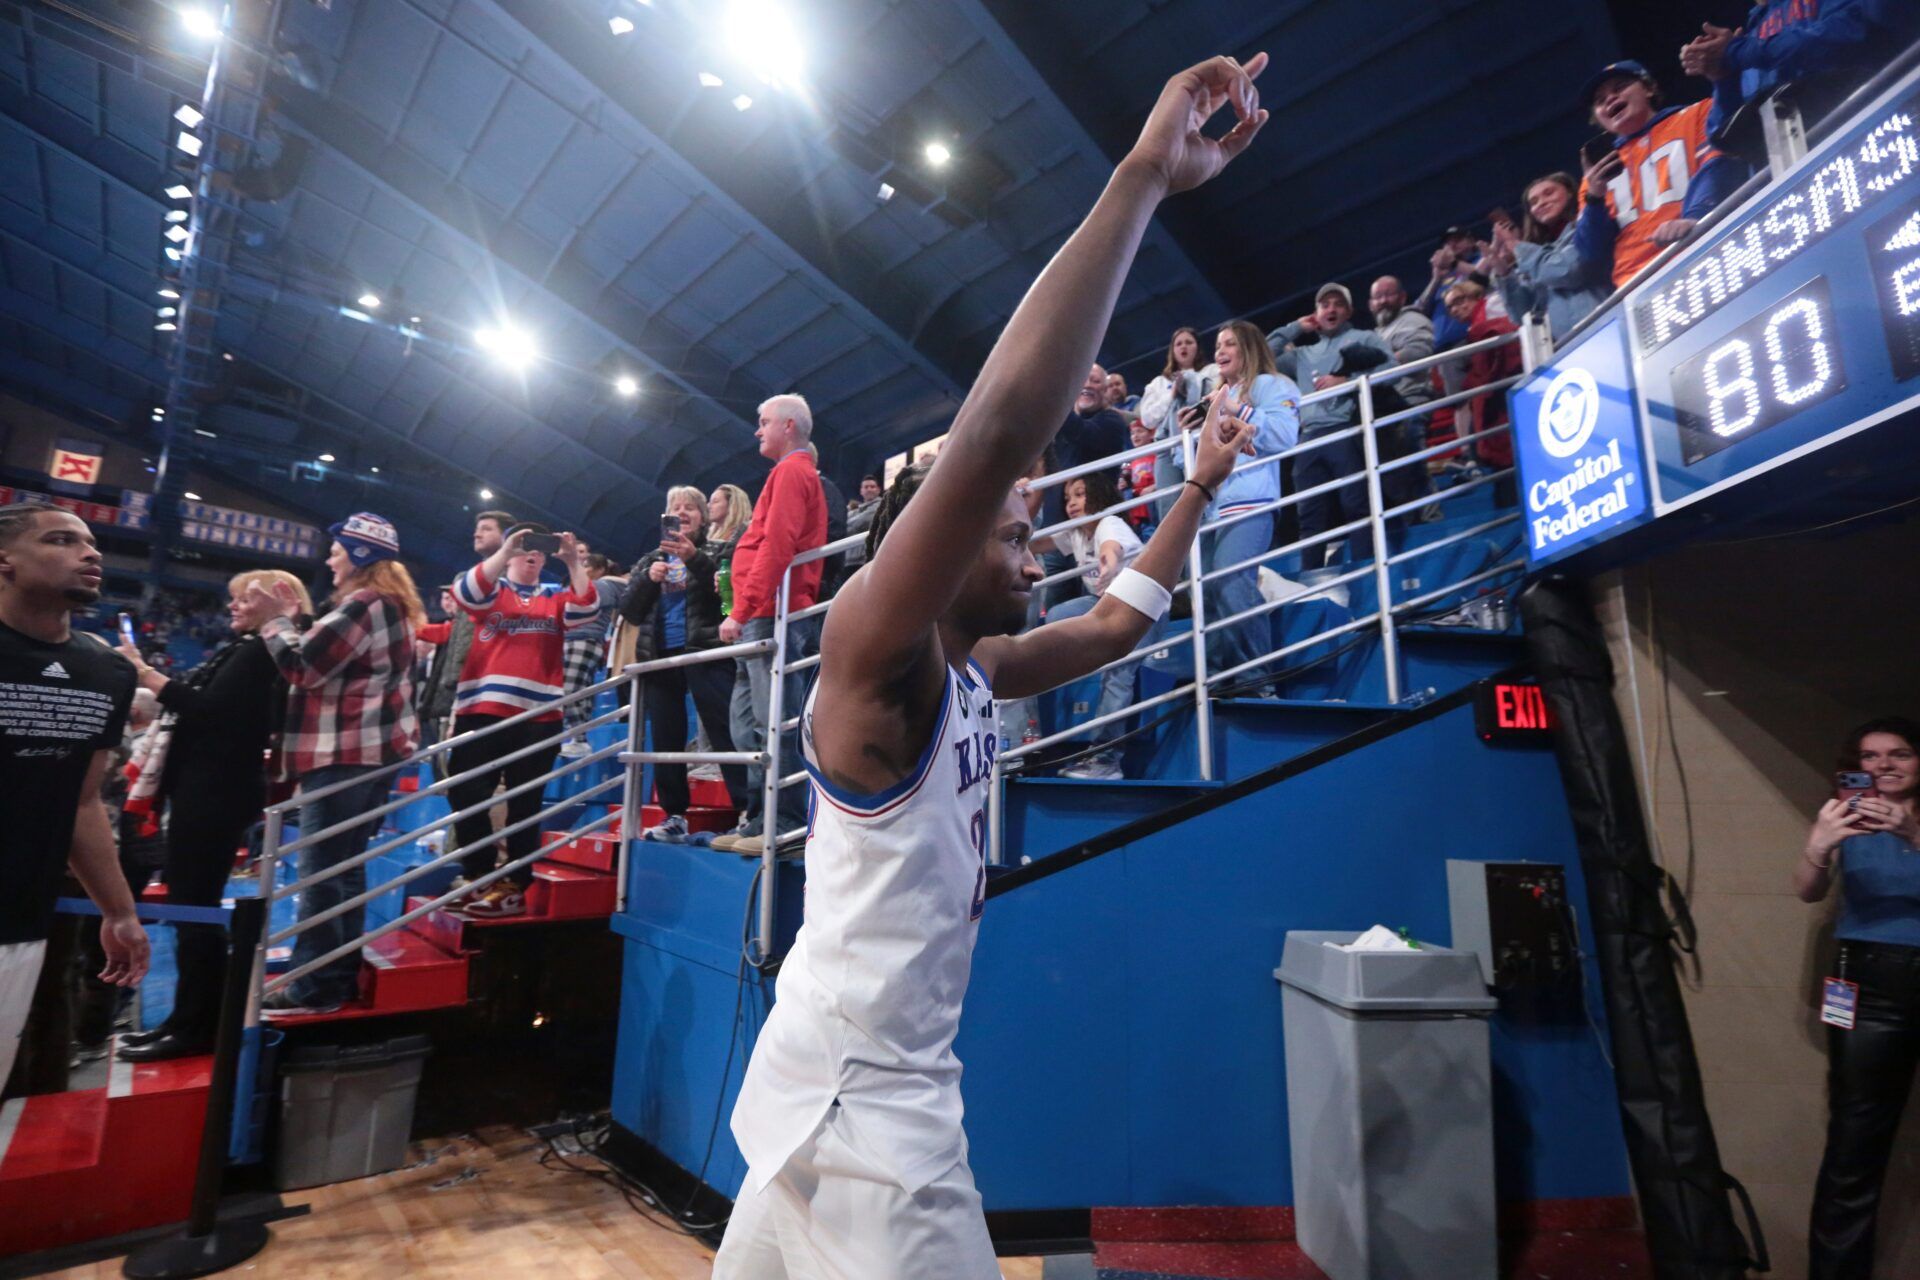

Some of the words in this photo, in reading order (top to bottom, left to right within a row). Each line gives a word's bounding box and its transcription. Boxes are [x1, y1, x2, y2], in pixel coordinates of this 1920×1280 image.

[1606, 138, 1689, 229] 10
[1651, 112, 1919, 343] KANSAS
[1702, 297, 1831, 437] 80
[1529, 438, 1623, 513] Capitol
[1532, 476, 1629, 549] Federal
[1495, 685, 1547, 729] EXIT
